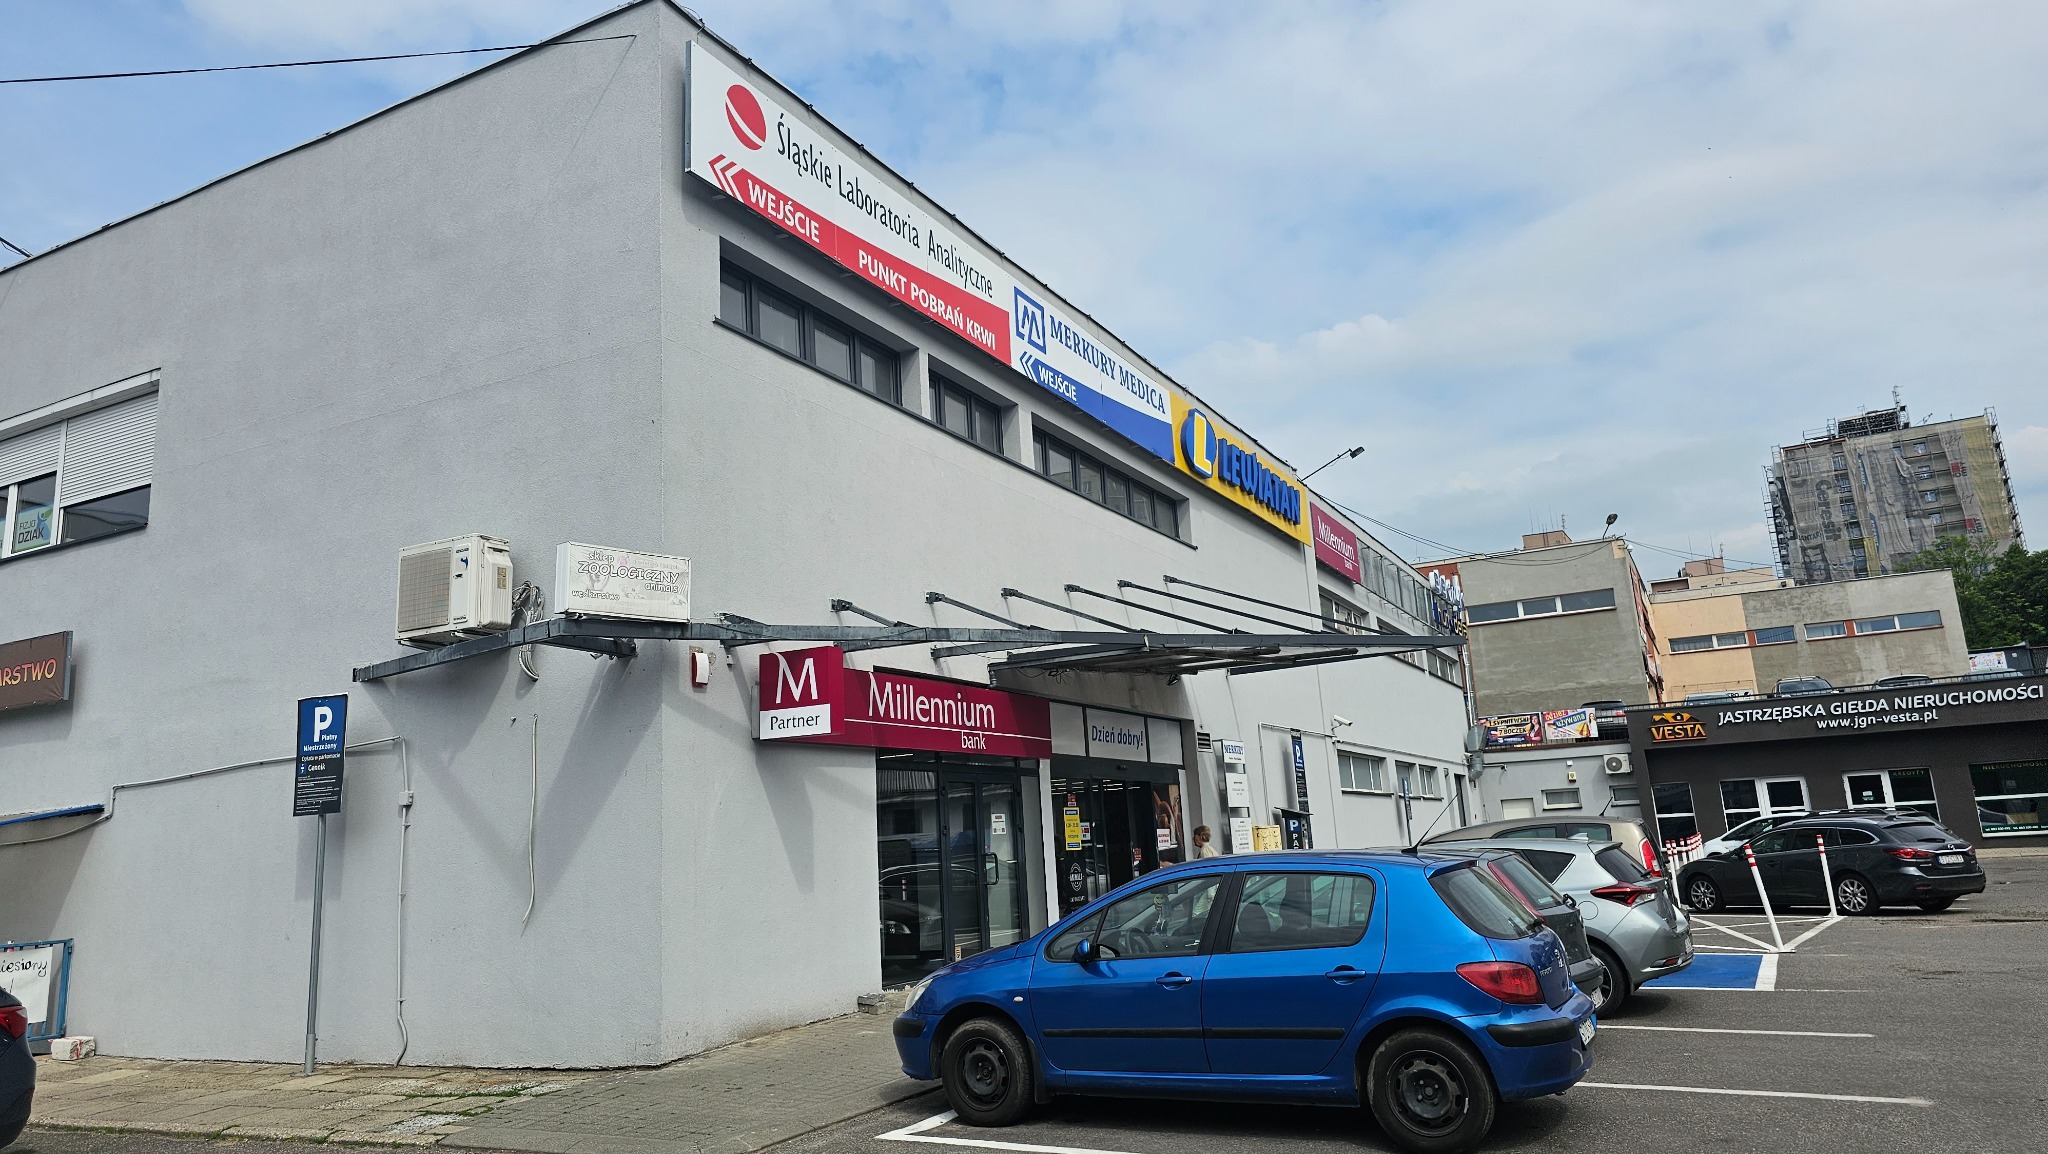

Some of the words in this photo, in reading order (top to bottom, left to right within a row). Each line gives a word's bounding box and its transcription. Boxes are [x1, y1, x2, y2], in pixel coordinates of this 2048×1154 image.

[748, 178, 820, 244] WEJŚCIE
[777, 112, 832, 188] Śląskie
[837, 164, 920, 249] Laboratoria
[927, 229, 993, 299] Analityczne
[858, 249, 907, 293] PUNKT
[910, 281, 964, 329] POBRAŃ
[966, 317, 996, 351] KRWI
[1049, 314, 1116, 380] MERKURY
[1118, 365, 1166, 415] MEDICA
[1038, 364, 1077, 402] WEJŚCIE
[1217, 438, 1300, 526] LEWIATAN
[17, 526, 45, 544] DZIAK
[1317, 515, 1355, 561] Millennium
[588, 550, 614, 564] sklep
[577, 560, 679, 584] ZOOLOGICZNY
[644, 581, 679, 593] animals
[0, 658, 57, 686] RSTWO
[770, 652, 818, 704] M
[868, 671, 996, 729] Millennium
[1718, 703, 1826, 726] JASTRZĘBSKA
[1830, 698, 1889, 715] GIEŁDA
[1894, 683, 2044, 710] NIERUCHOMOŚCI
[314, 706, 333, 743] P
[769, 712, 820, 731] Partner
[1651, 724, 1706, 739] VESTA
[1816, 709, 1938, 729] www.jgn-vesta.pl
[961, 731, 986, 750] bank
[1091, 725, 1115, 744] Dzień
[1117, 727, 1143, 750] dobry!
[1892, 768, 1925, 777] KREDYTY
[1289, 819, 1299, 832] P
[0, 958, 48, 978] iesiony
